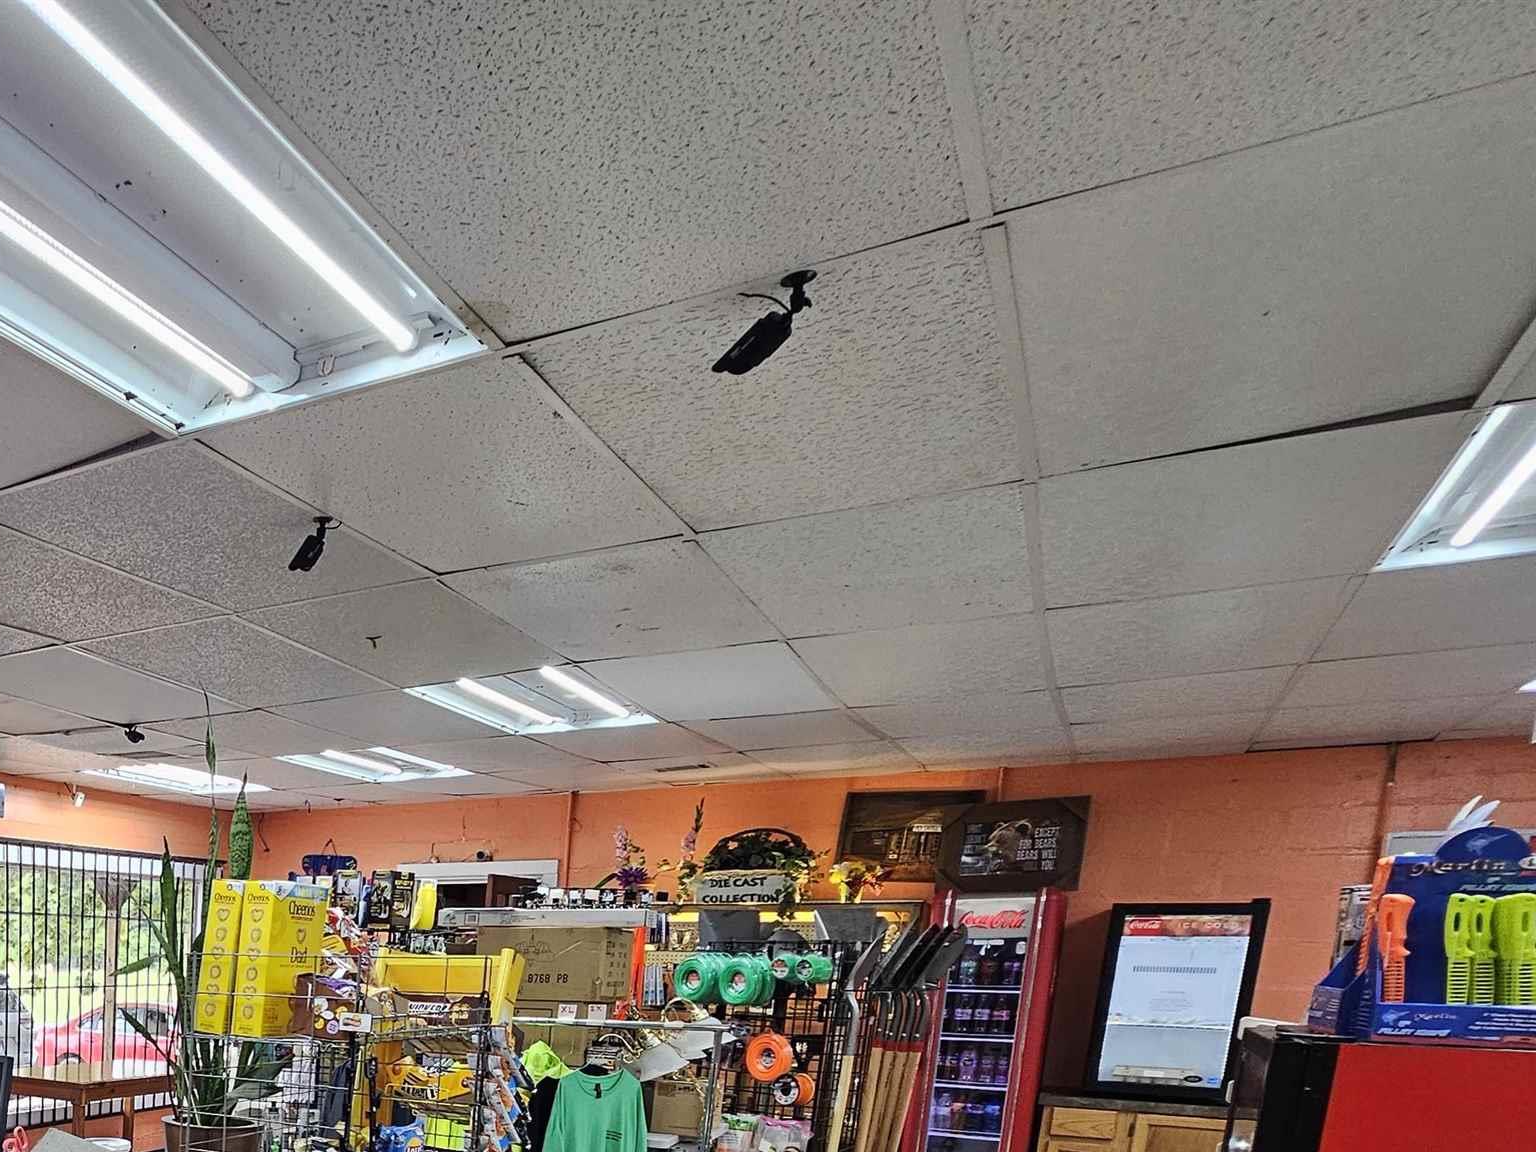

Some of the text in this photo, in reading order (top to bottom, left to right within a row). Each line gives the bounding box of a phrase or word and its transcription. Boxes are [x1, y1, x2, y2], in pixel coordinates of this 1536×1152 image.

[1034, 838, 1056, 849] BEARS
[710, 876, 767, 888] DIE CAST
[702, 893, 779, 904] COLLECTION
[959, 909, 1030, 930] Coca-Cola
[1129, 920, 1162, 930] Coca-Cola
[559, 1005, 575, 1014] XL
